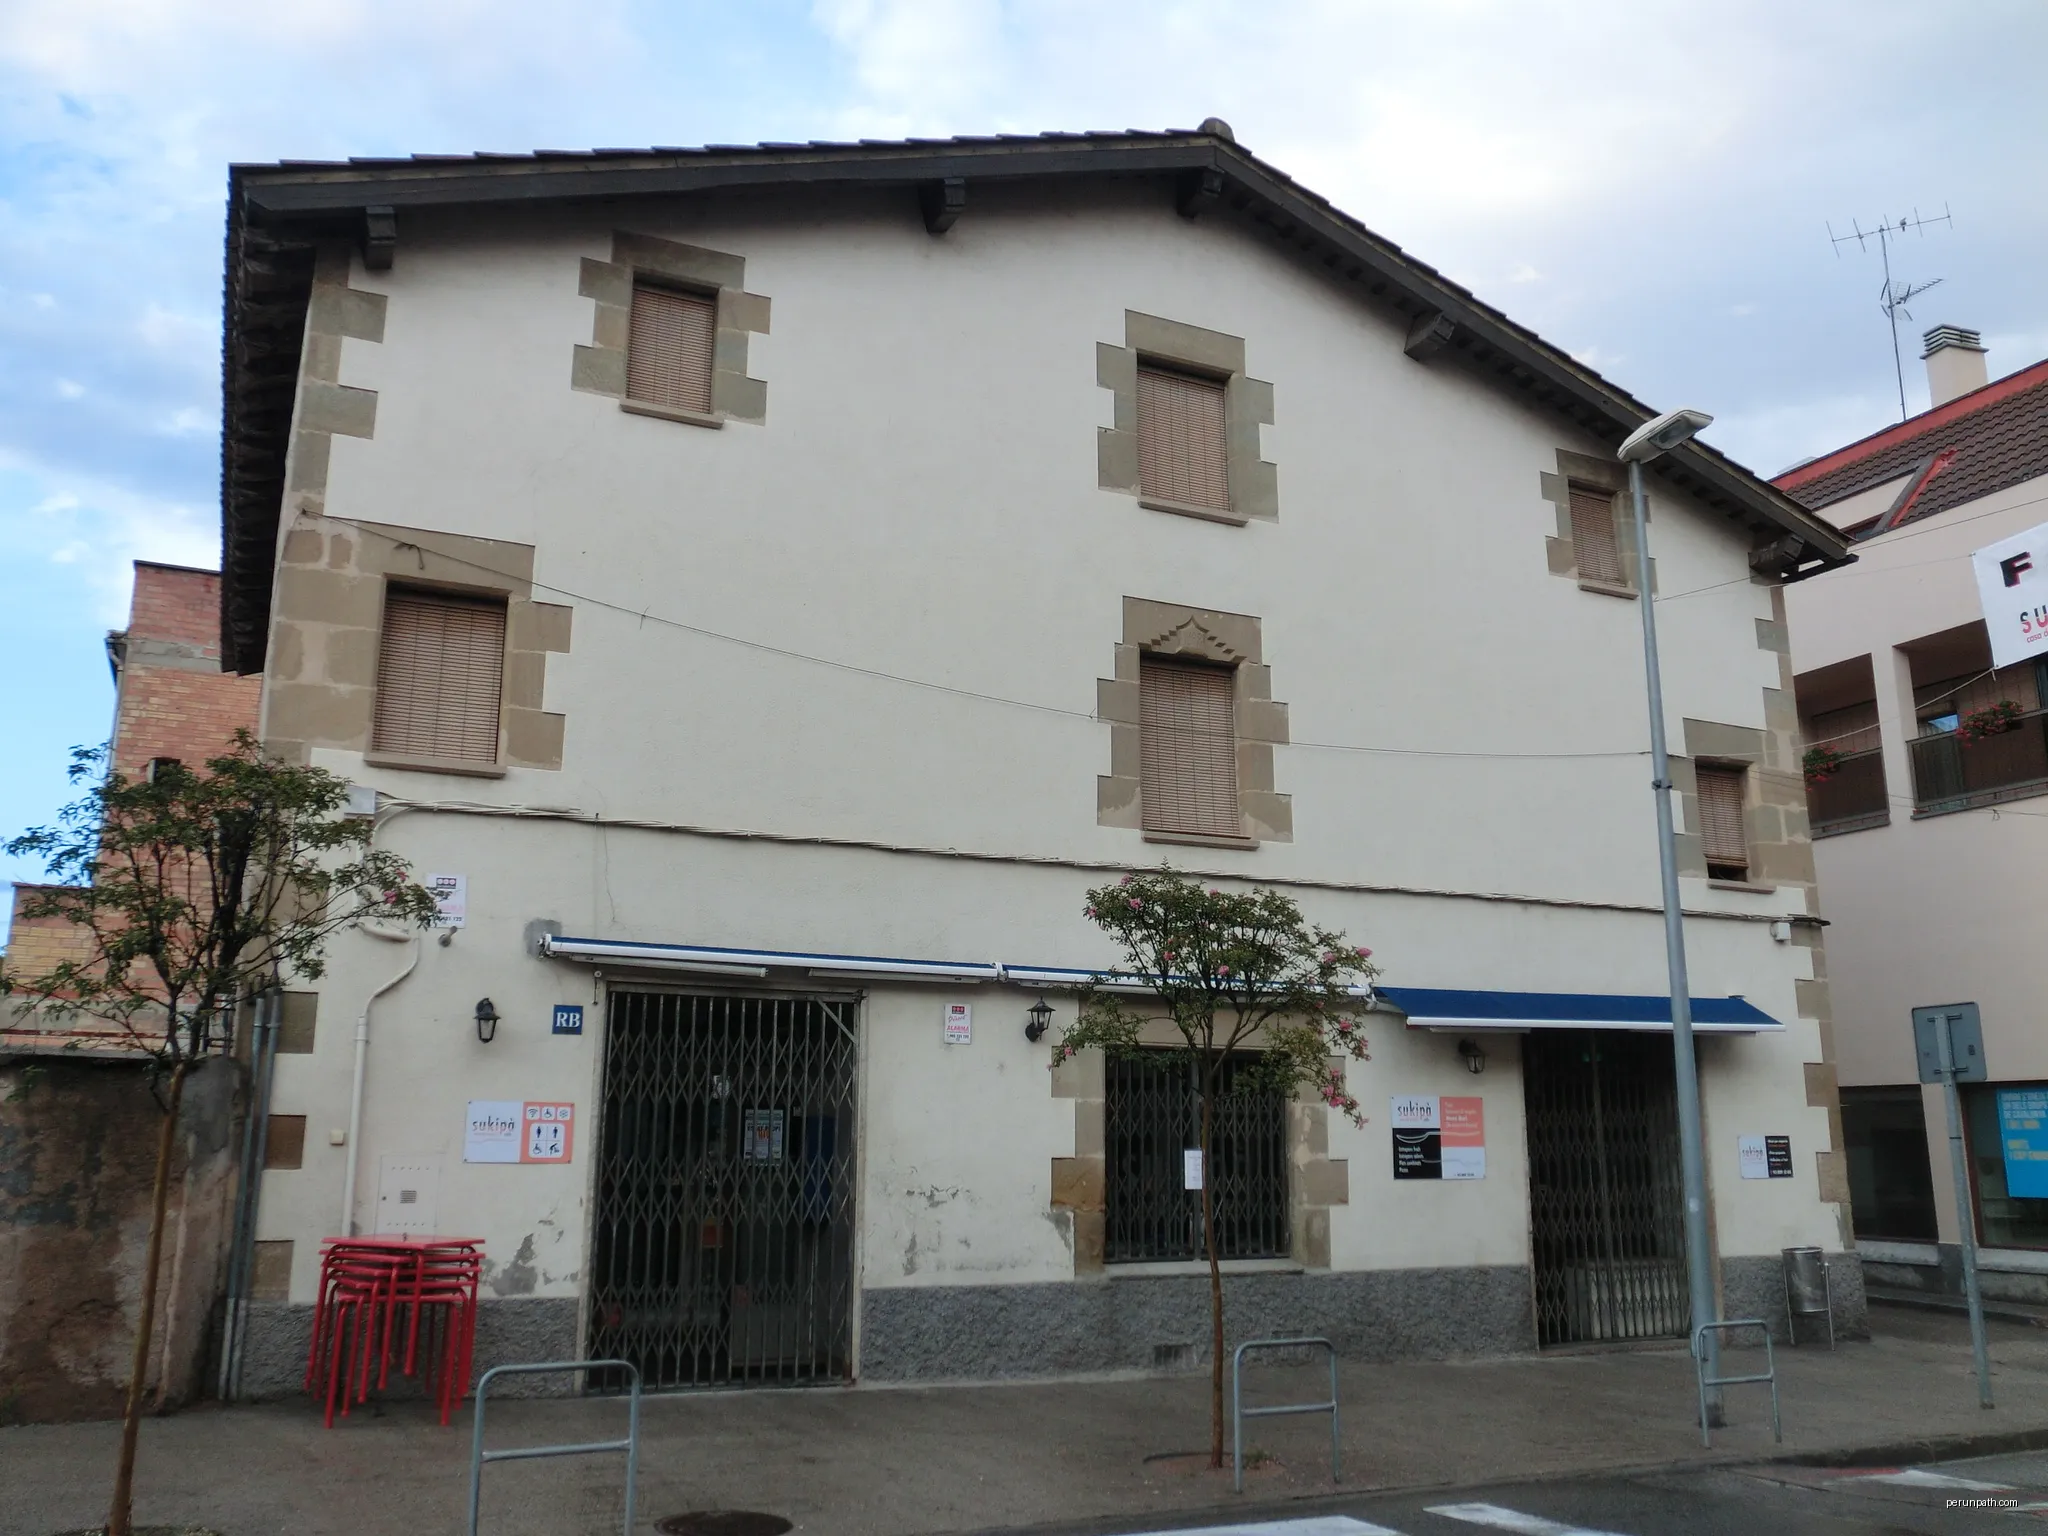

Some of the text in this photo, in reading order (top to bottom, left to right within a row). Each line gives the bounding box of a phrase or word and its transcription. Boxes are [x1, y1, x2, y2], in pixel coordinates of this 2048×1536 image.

[1999, 551, 2033, 588] F
[2026, 633, 2042, 643] casa
[555, 1012, 580, 1028] RB
[1397, 1101, 1432, 1120] sukipà
[472, 1115, 515, 1134] sukipà
